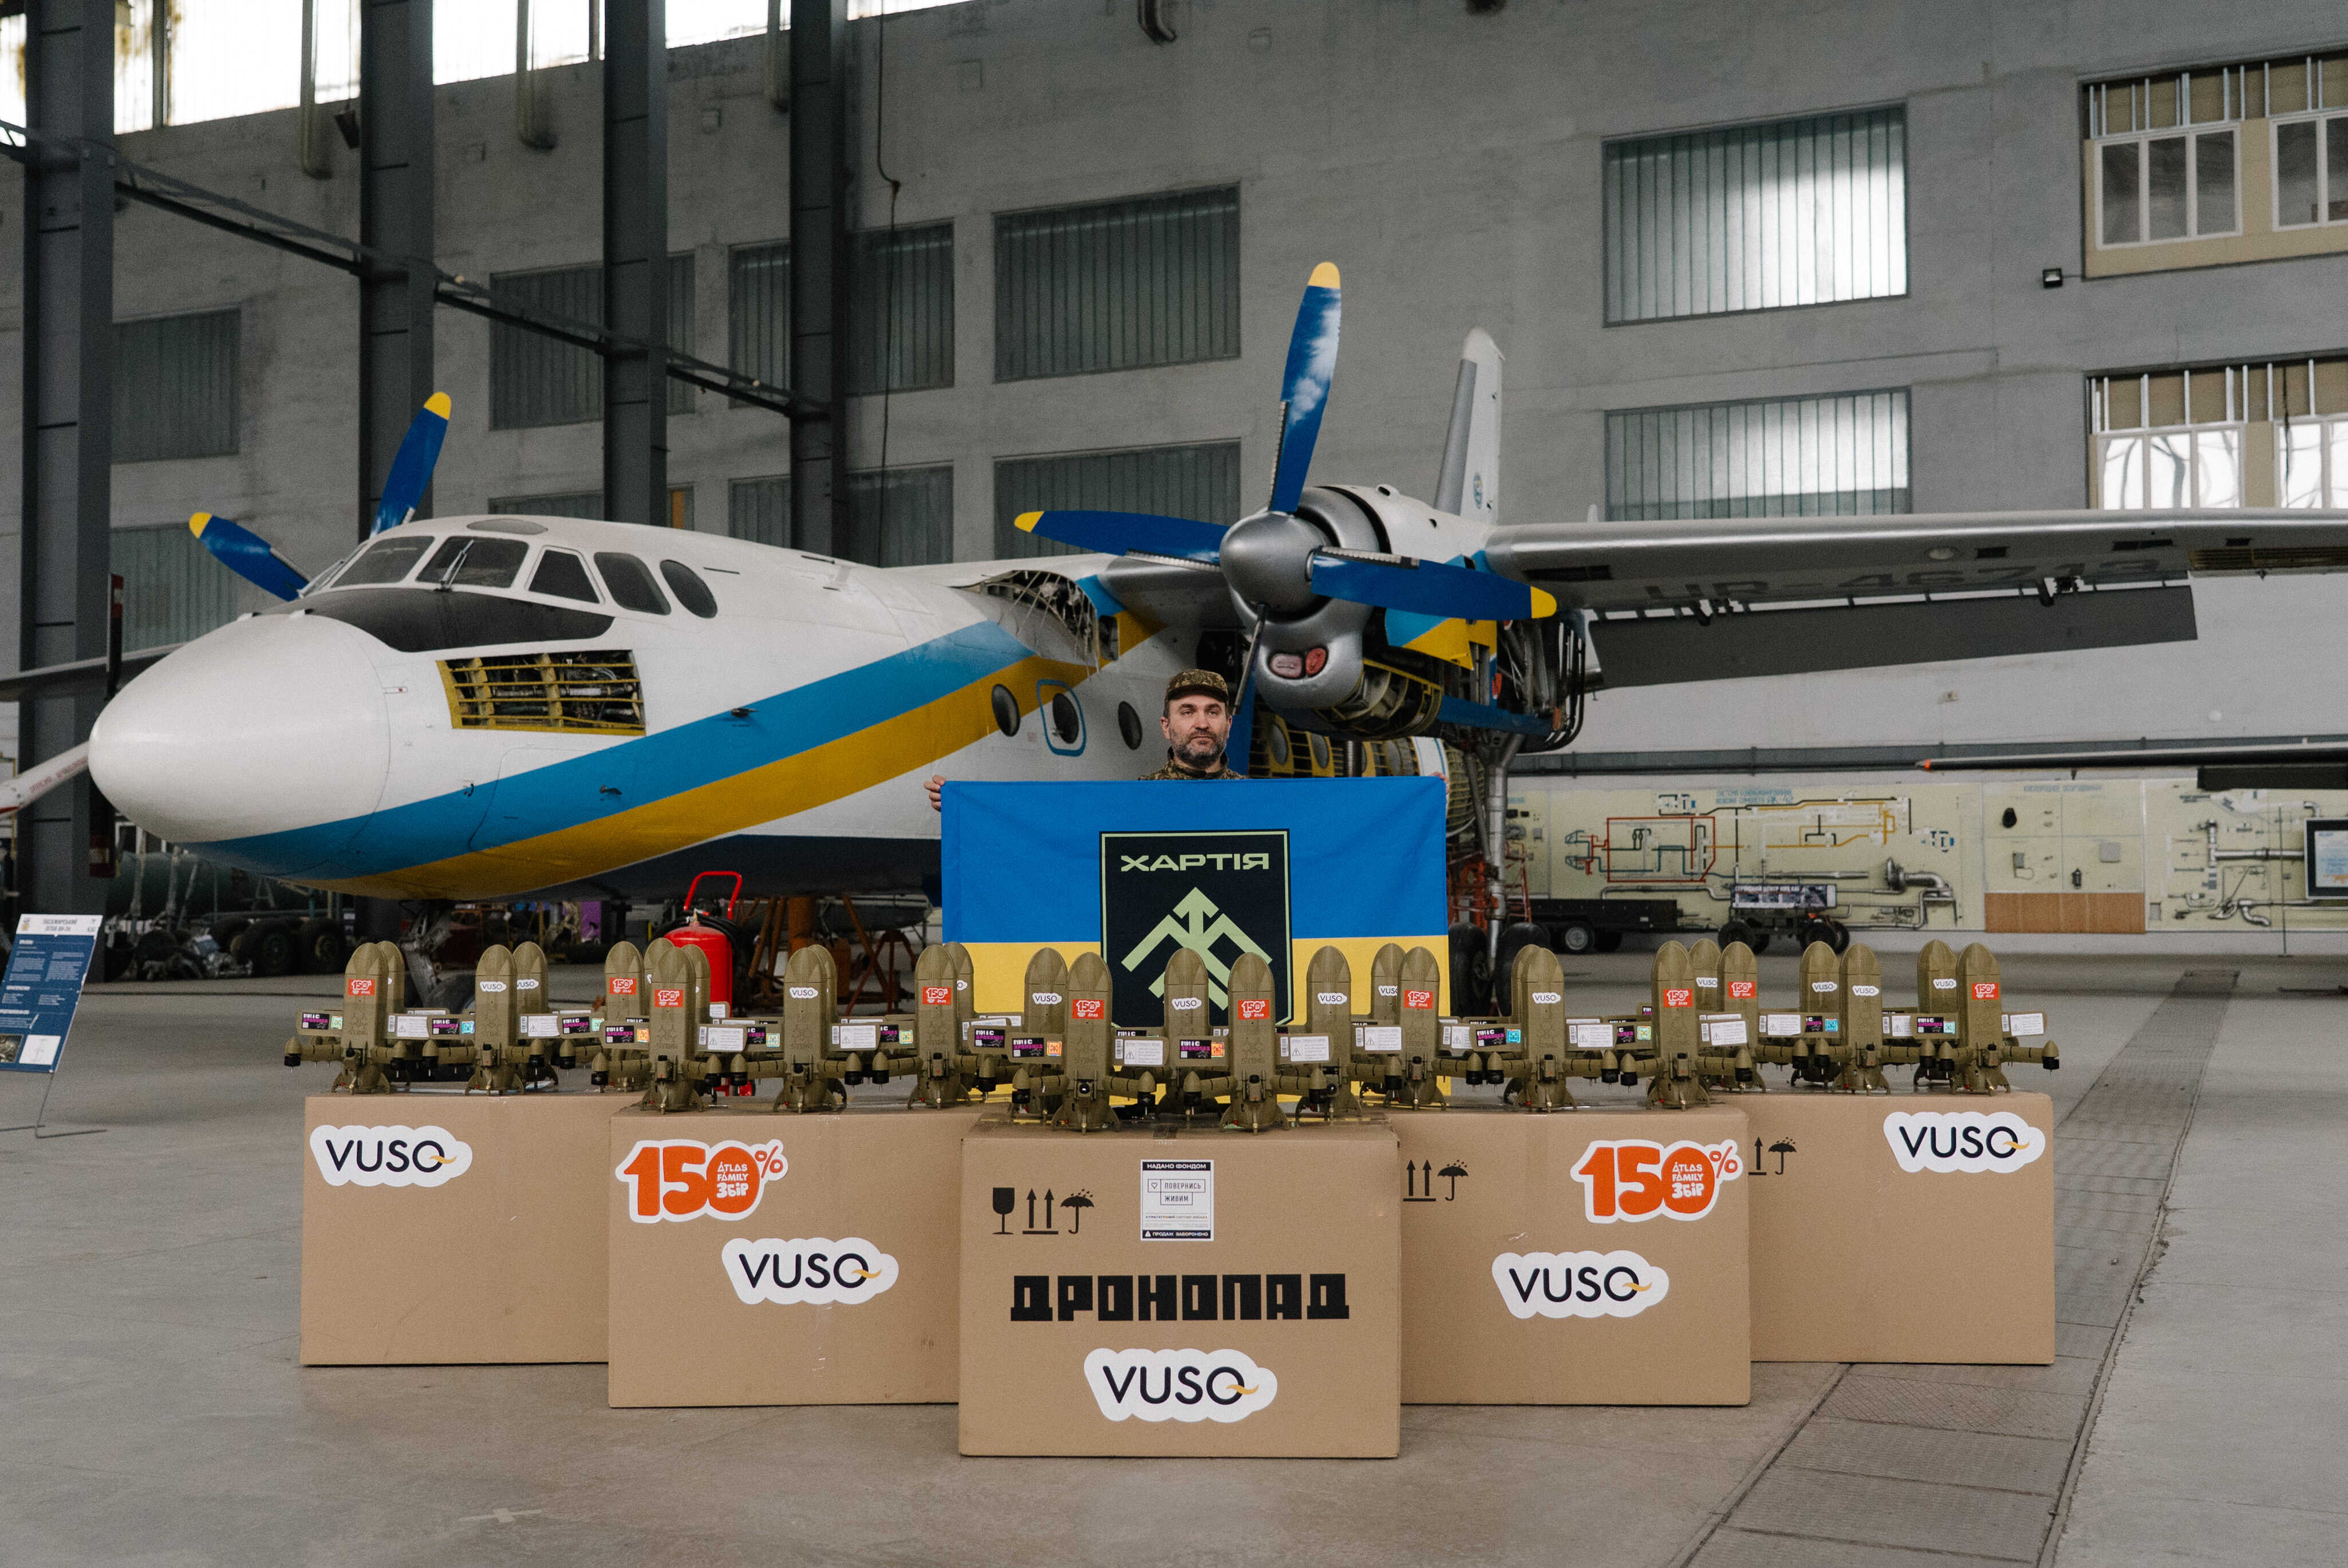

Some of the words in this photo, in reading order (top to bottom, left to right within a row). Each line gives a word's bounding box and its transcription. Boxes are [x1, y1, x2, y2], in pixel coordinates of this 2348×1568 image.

[1121, 853, 1269, 872] ХАРТІЯ
[326, 1140, 445, 1172] VUSO
[1899, 1126, 2018, 1158] VUSO
[623, 1145, 783, 1216] 150%
[1579, 1146, 1738, 1217] 150%
[739, 1253, 869, 1288] VUSO
[1509, 1266, 1639, 1302] VUSO
[1011, 1274, 1349, 1321] ДРОНОПАД
[1103, 1366, 1245, 1405] VUSO
